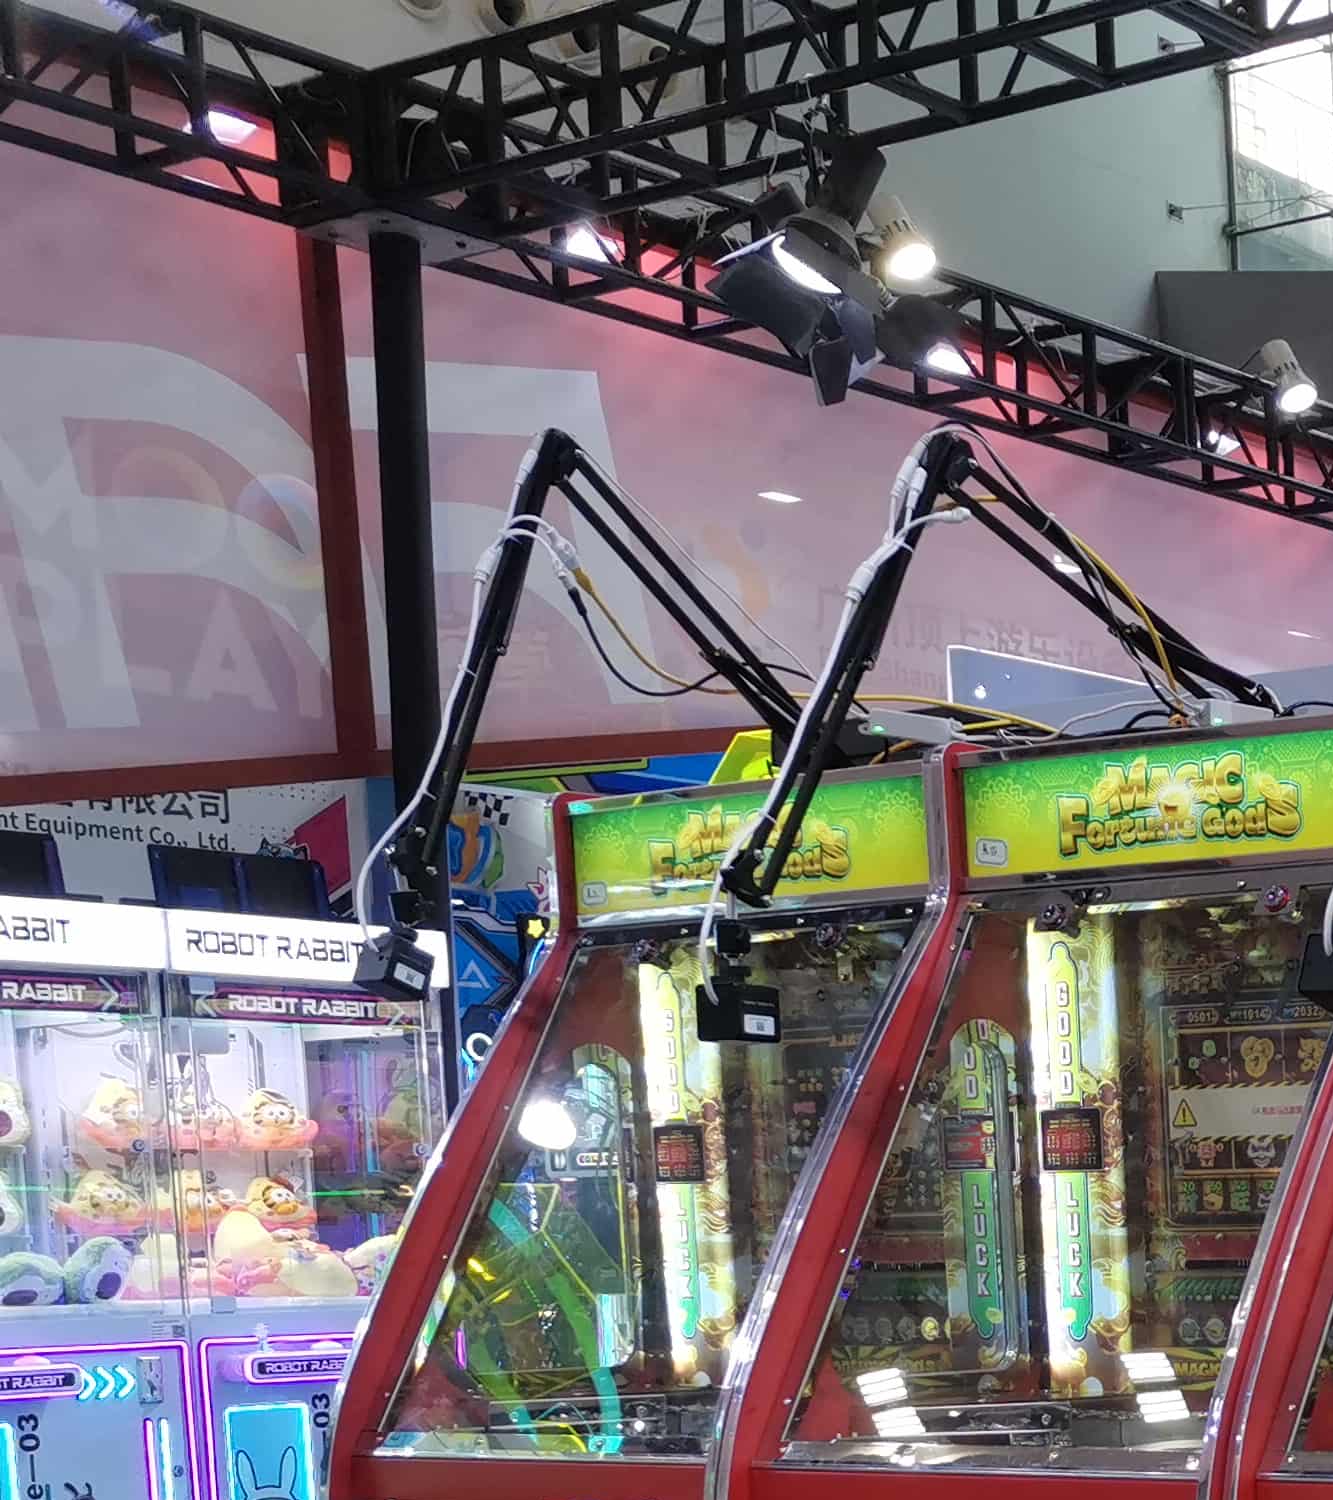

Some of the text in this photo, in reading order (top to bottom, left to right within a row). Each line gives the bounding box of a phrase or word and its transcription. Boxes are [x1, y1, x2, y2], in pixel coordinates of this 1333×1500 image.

[25, 813, 143, 843] Equipment
[197, 831, 236, 852] Ltd.
[186, 928, 268, 957] ROBOT
[1, 981, 87, 1003] RABBIT
[227, 994, 378, 1018] ROBOT RABBIT
[1064, 1181, 1085, 1300] LUCK
[265, 1361, 308, 1373] ROBOT
